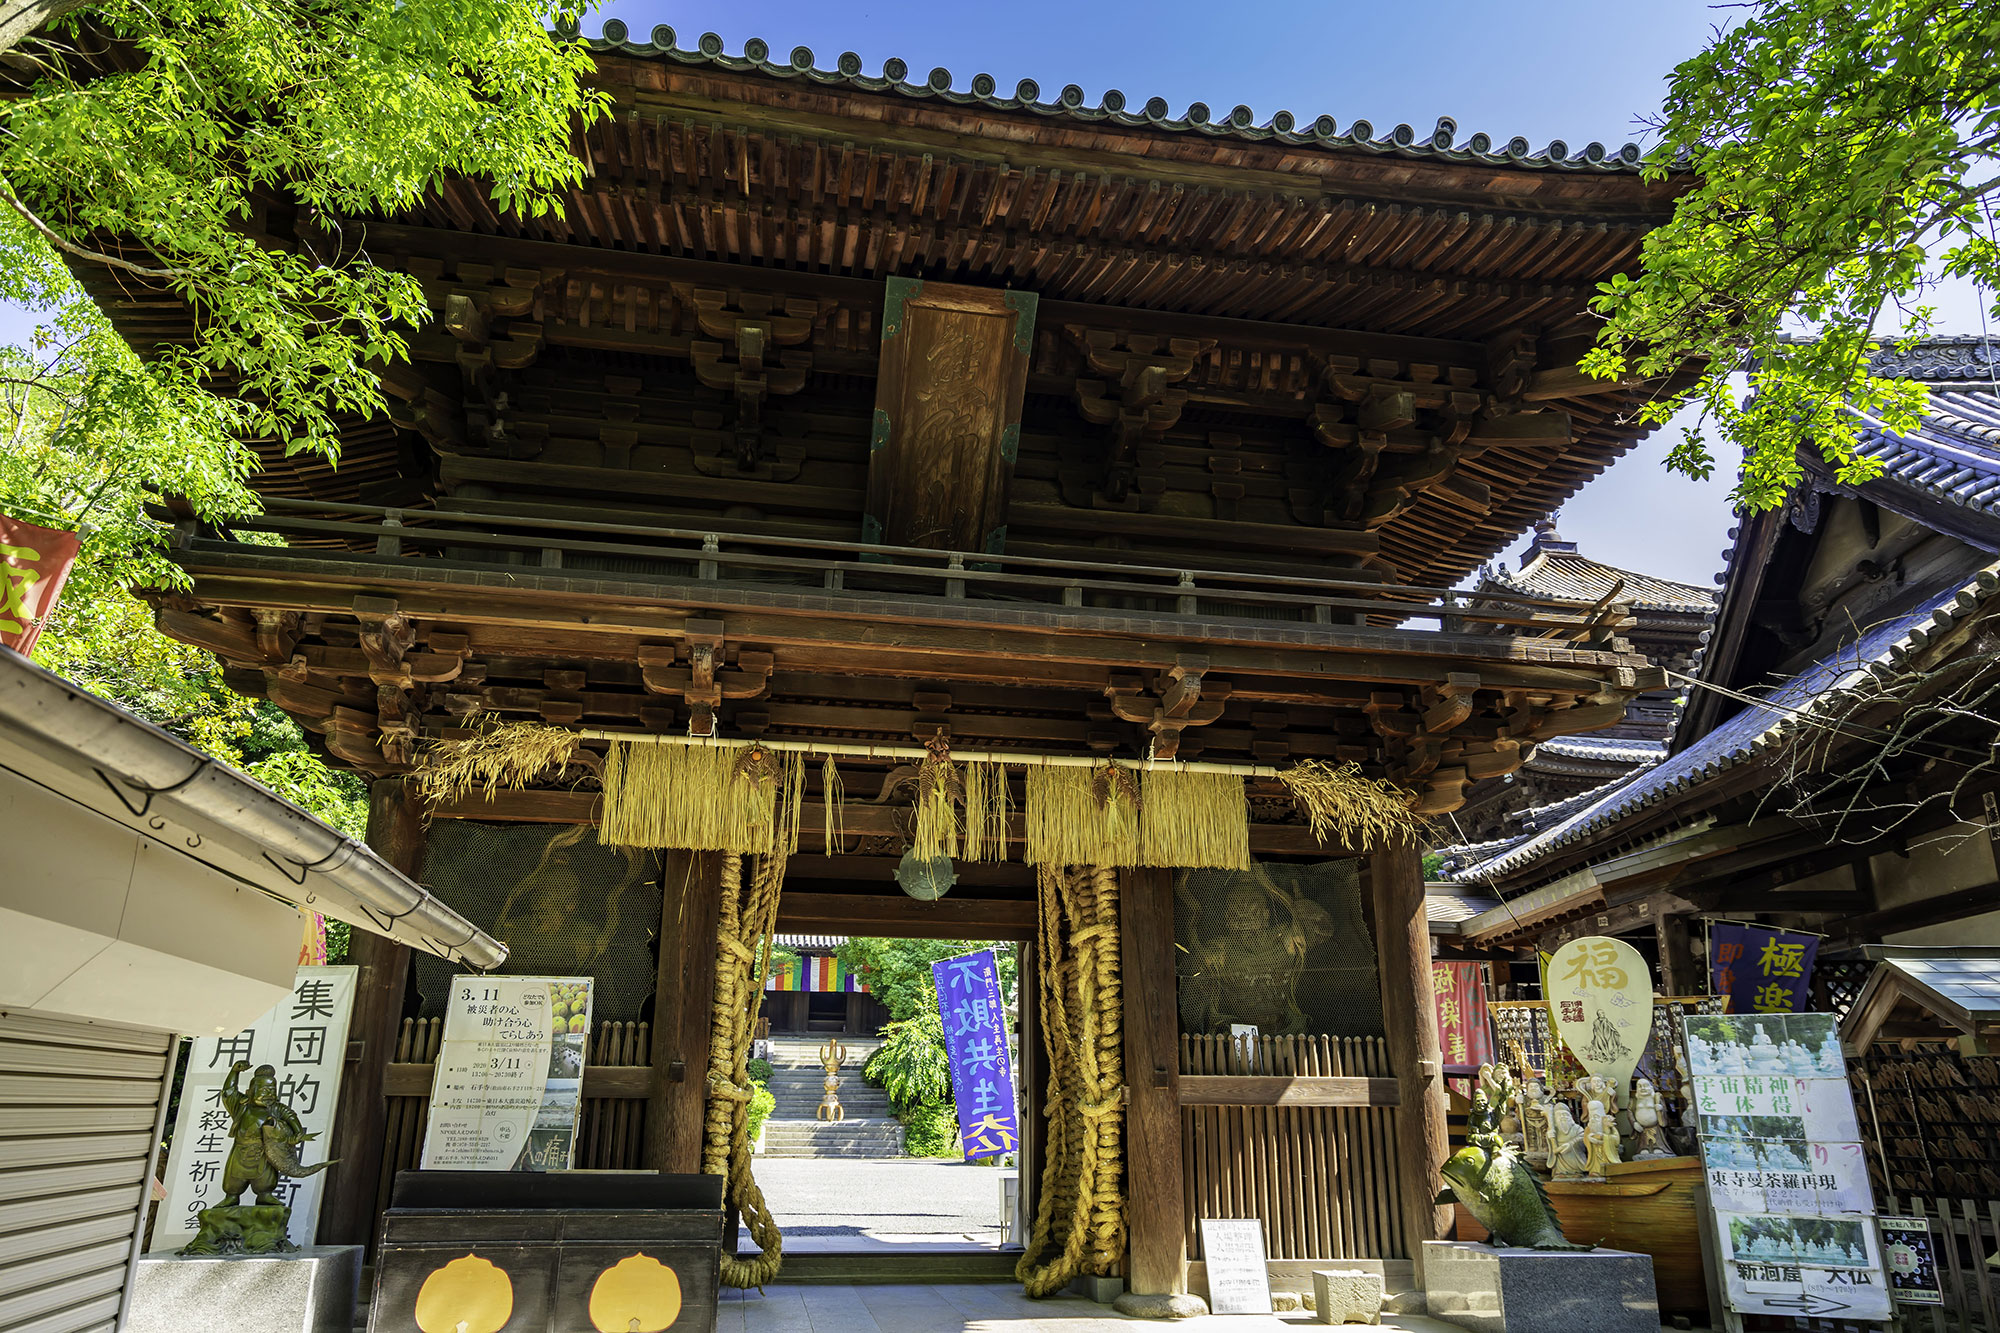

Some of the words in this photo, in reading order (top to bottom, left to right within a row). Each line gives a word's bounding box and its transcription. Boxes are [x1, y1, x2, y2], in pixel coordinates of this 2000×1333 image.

[1561, 941, 1628, 990] 福
[1753, 937, 1805, 1013] 極楽
[466, 1004, 520, 1015] 被災者の心
[482, 1017, 532, 1028] 助け合う心
[500, 1030, 544, 1040] てらしあう
[490, 1057, 520, 1070] 3/11
[1695, 1077, 1789, 1095] 宇宙精神
[1711, 1171, 1838, 1191] 東寺曼荼羅再現
